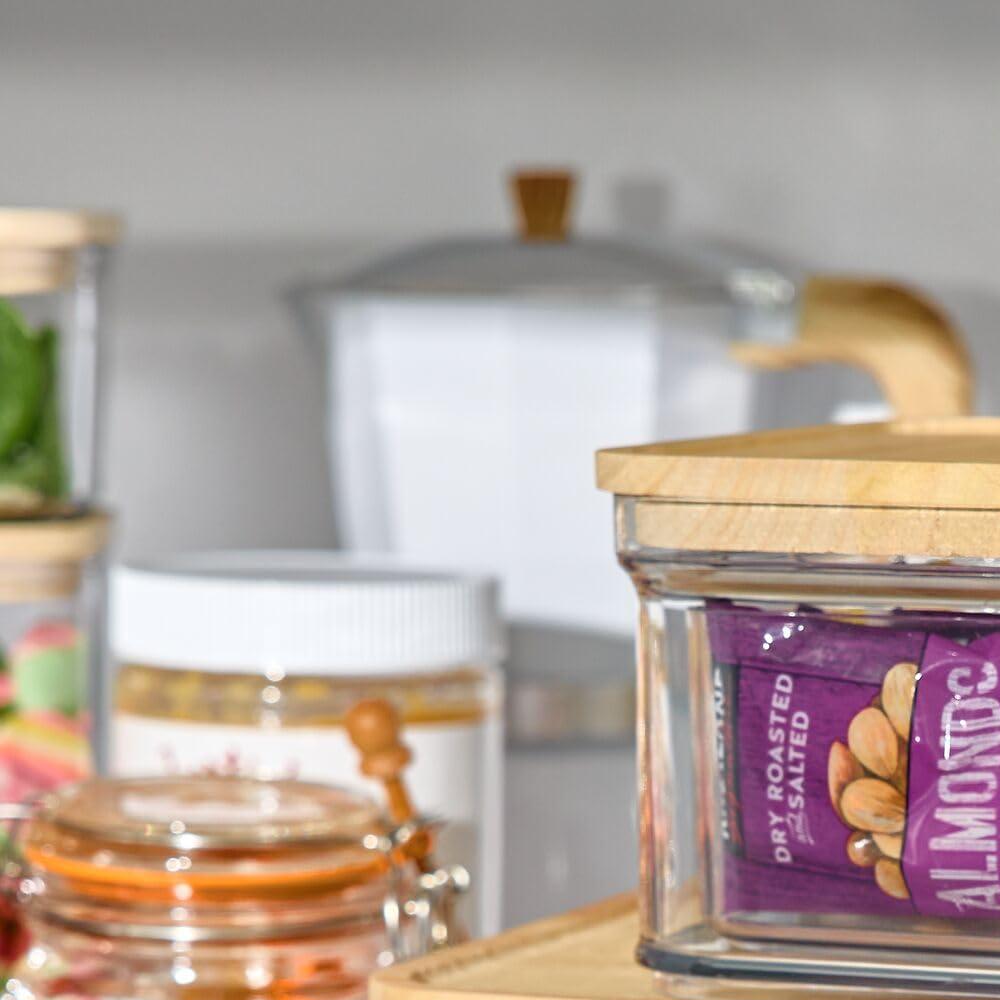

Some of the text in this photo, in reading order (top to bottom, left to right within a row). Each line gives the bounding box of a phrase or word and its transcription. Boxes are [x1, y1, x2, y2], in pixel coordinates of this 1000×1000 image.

[766, 673, 793, 864] DRY ROASTED
[788, 710, 810, 809] SALTED
